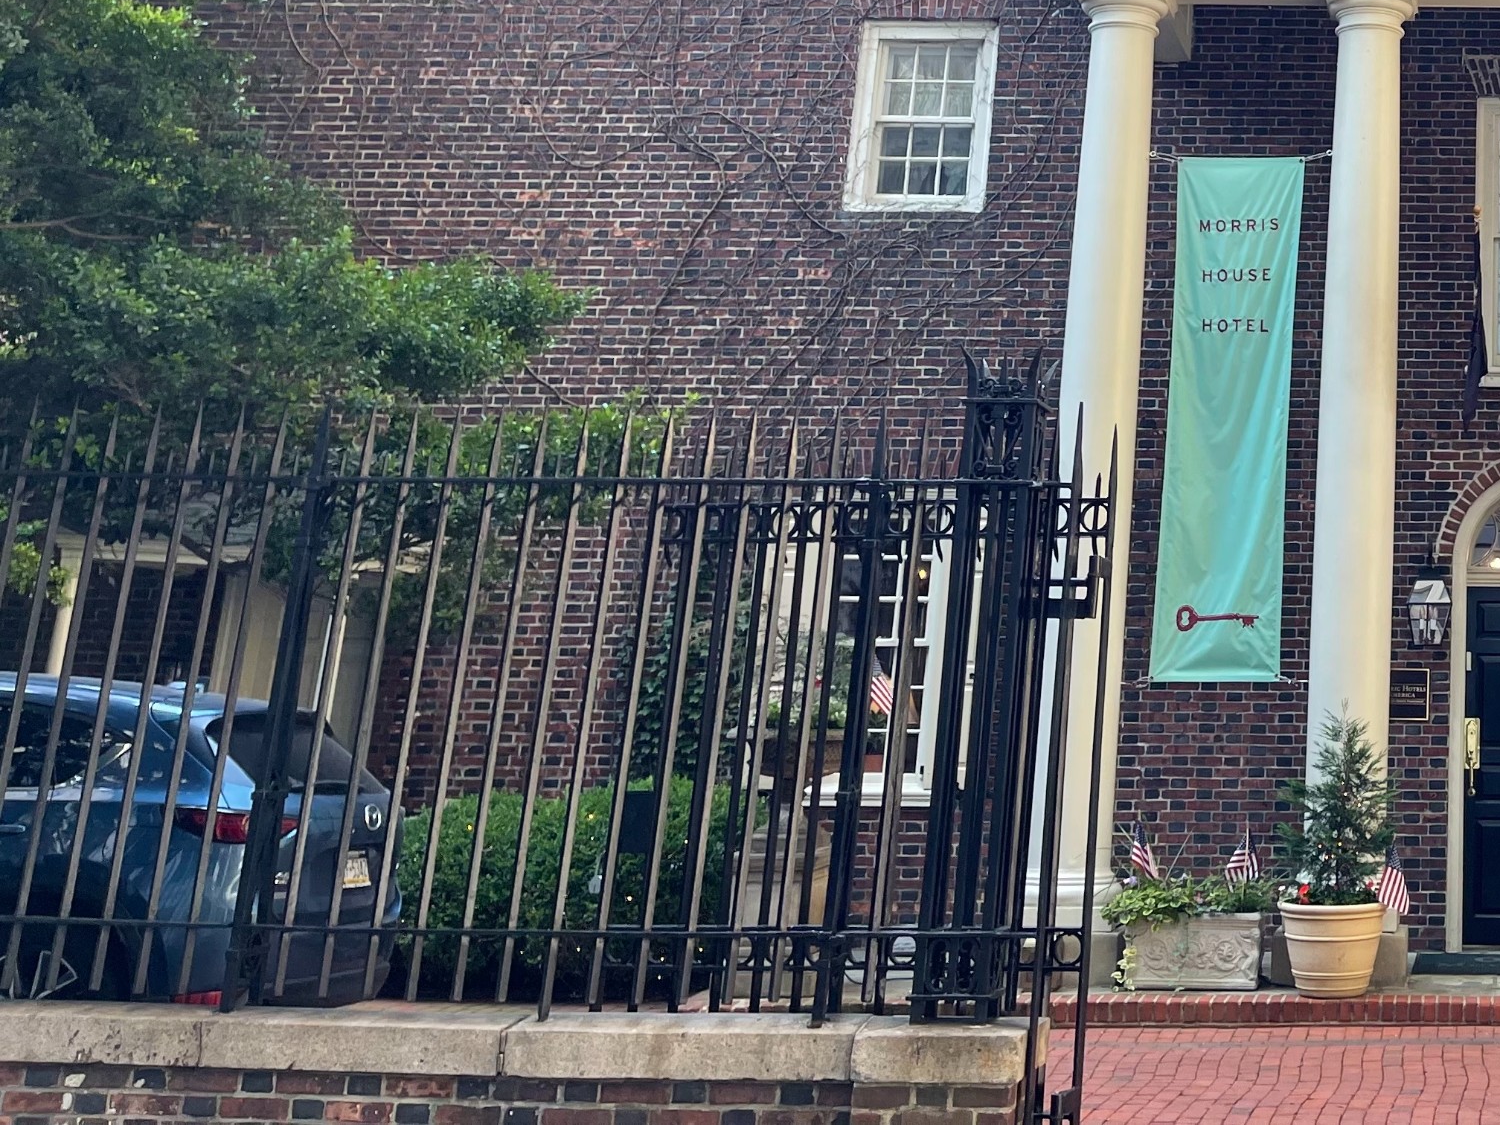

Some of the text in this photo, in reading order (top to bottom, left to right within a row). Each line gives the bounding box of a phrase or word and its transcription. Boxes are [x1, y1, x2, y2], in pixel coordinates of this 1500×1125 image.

[1199, 217, 1280, 233] MORRIS
[1202, 268, 1272, 283] HOUSE
[1202, 318, 1269, 333] HOTEL
